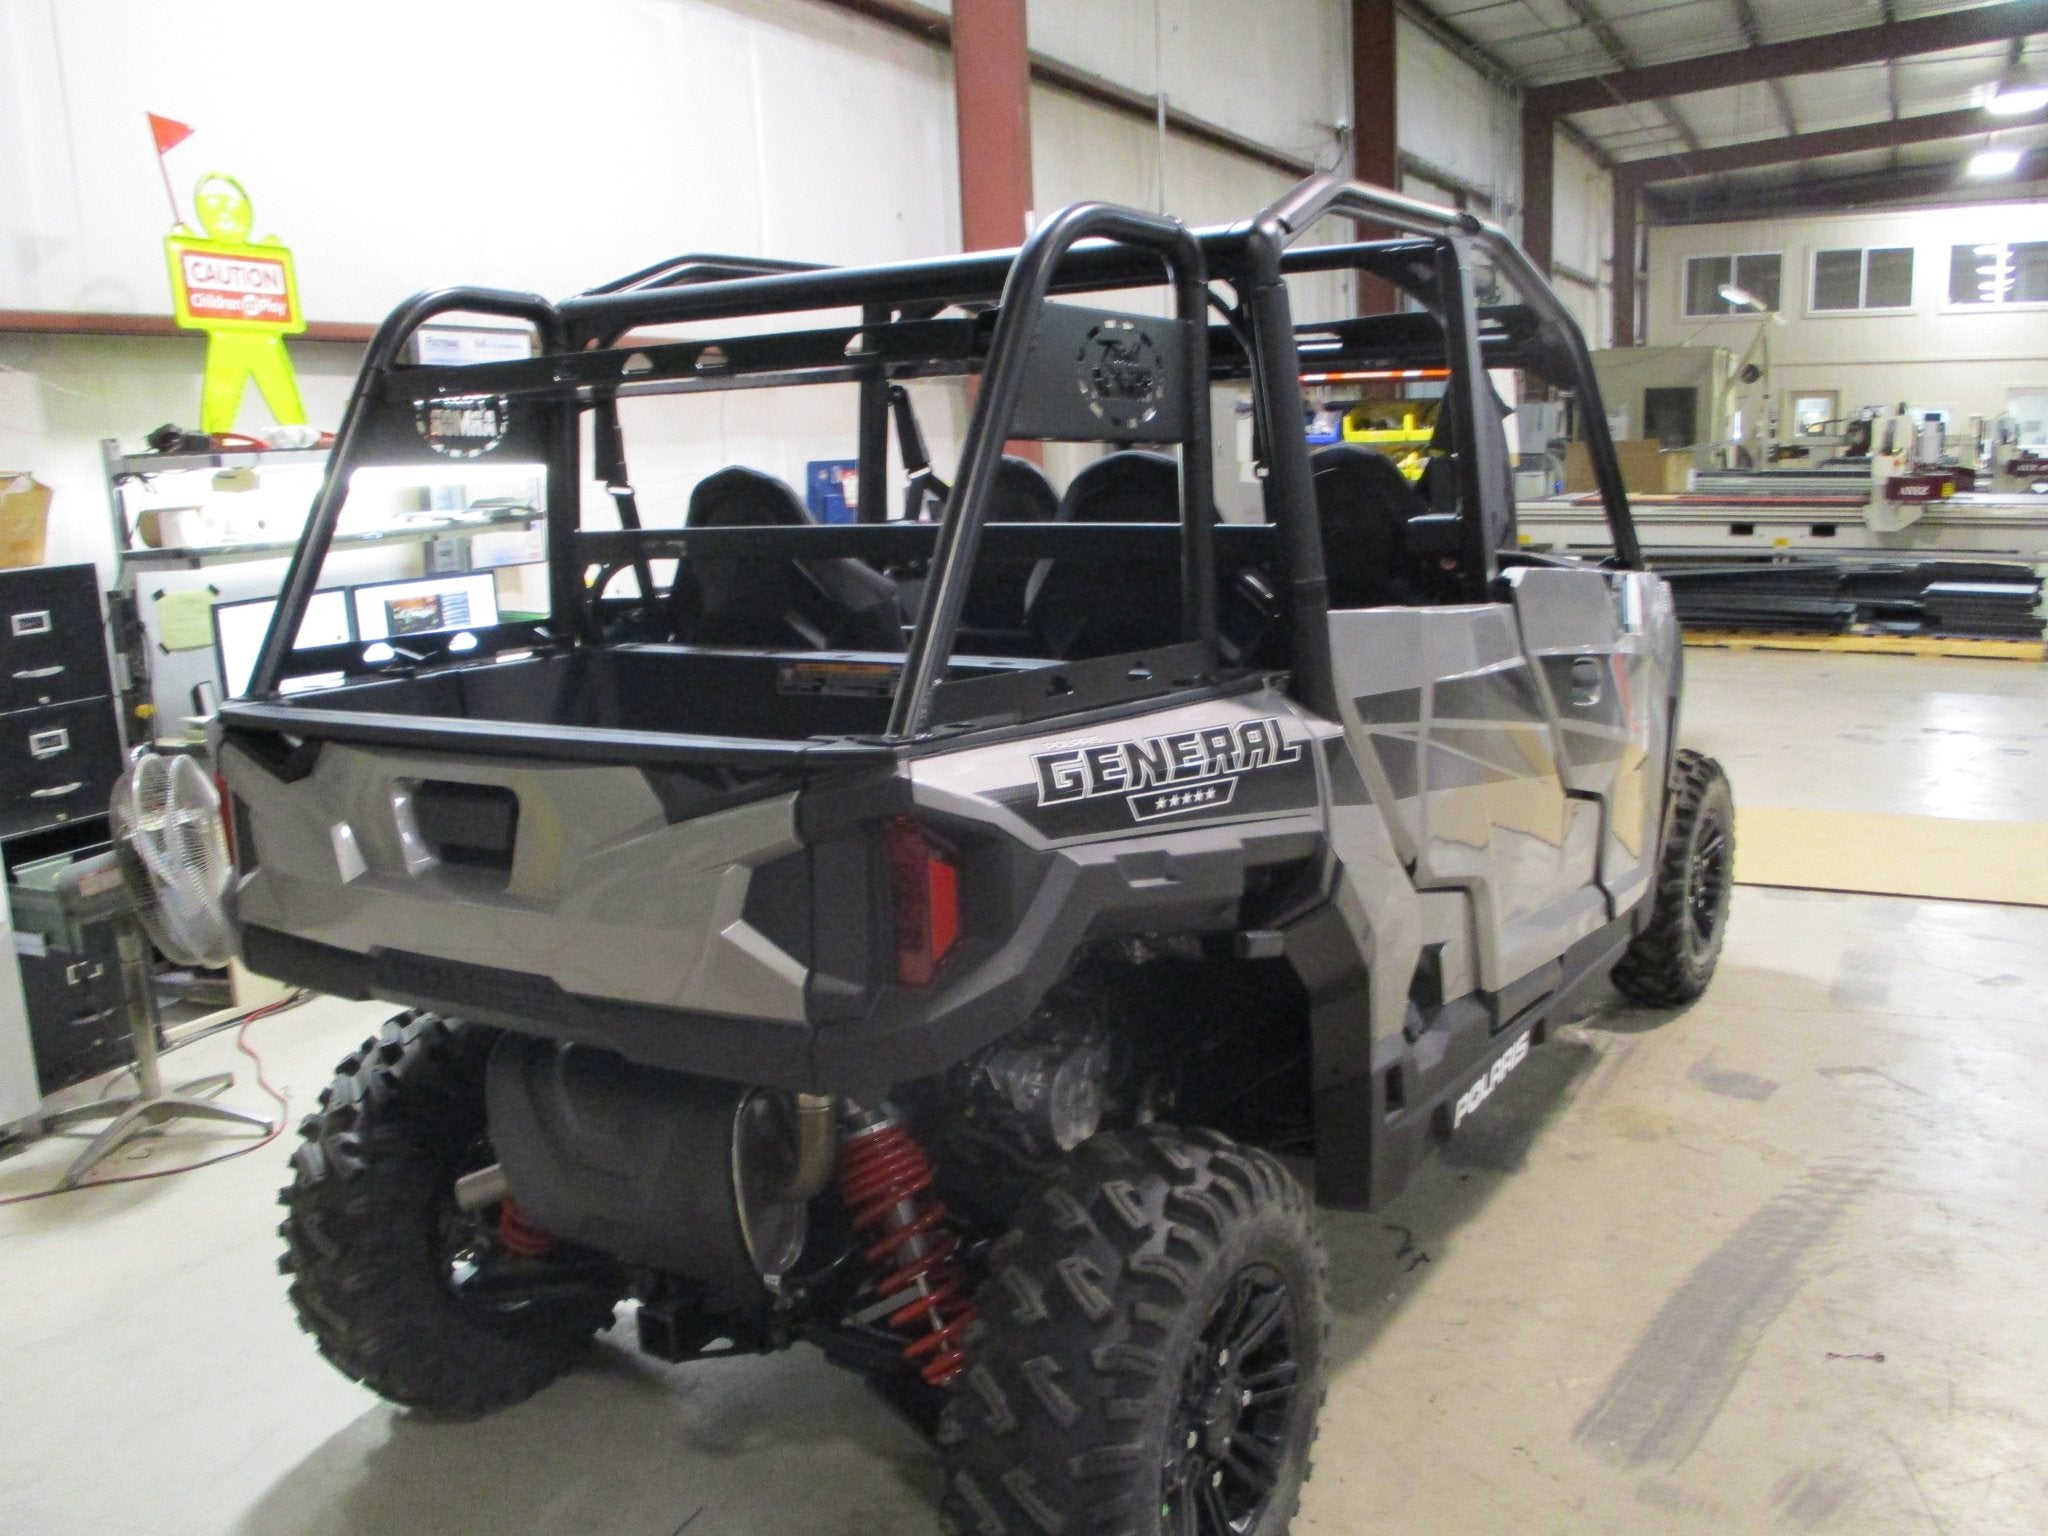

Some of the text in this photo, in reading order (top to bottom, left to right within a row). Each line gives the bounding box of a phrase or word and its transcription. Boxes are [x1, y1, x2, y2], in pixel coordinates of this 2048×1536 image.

[192, 262, 278, 288] CAUTION
[191, 293, 241, 311] Children
[256, 296, 287, 317] Play
[1030, 716, 1302, 807] GENERAL
[1453, 1030, 1531, 1129] POLARIS
